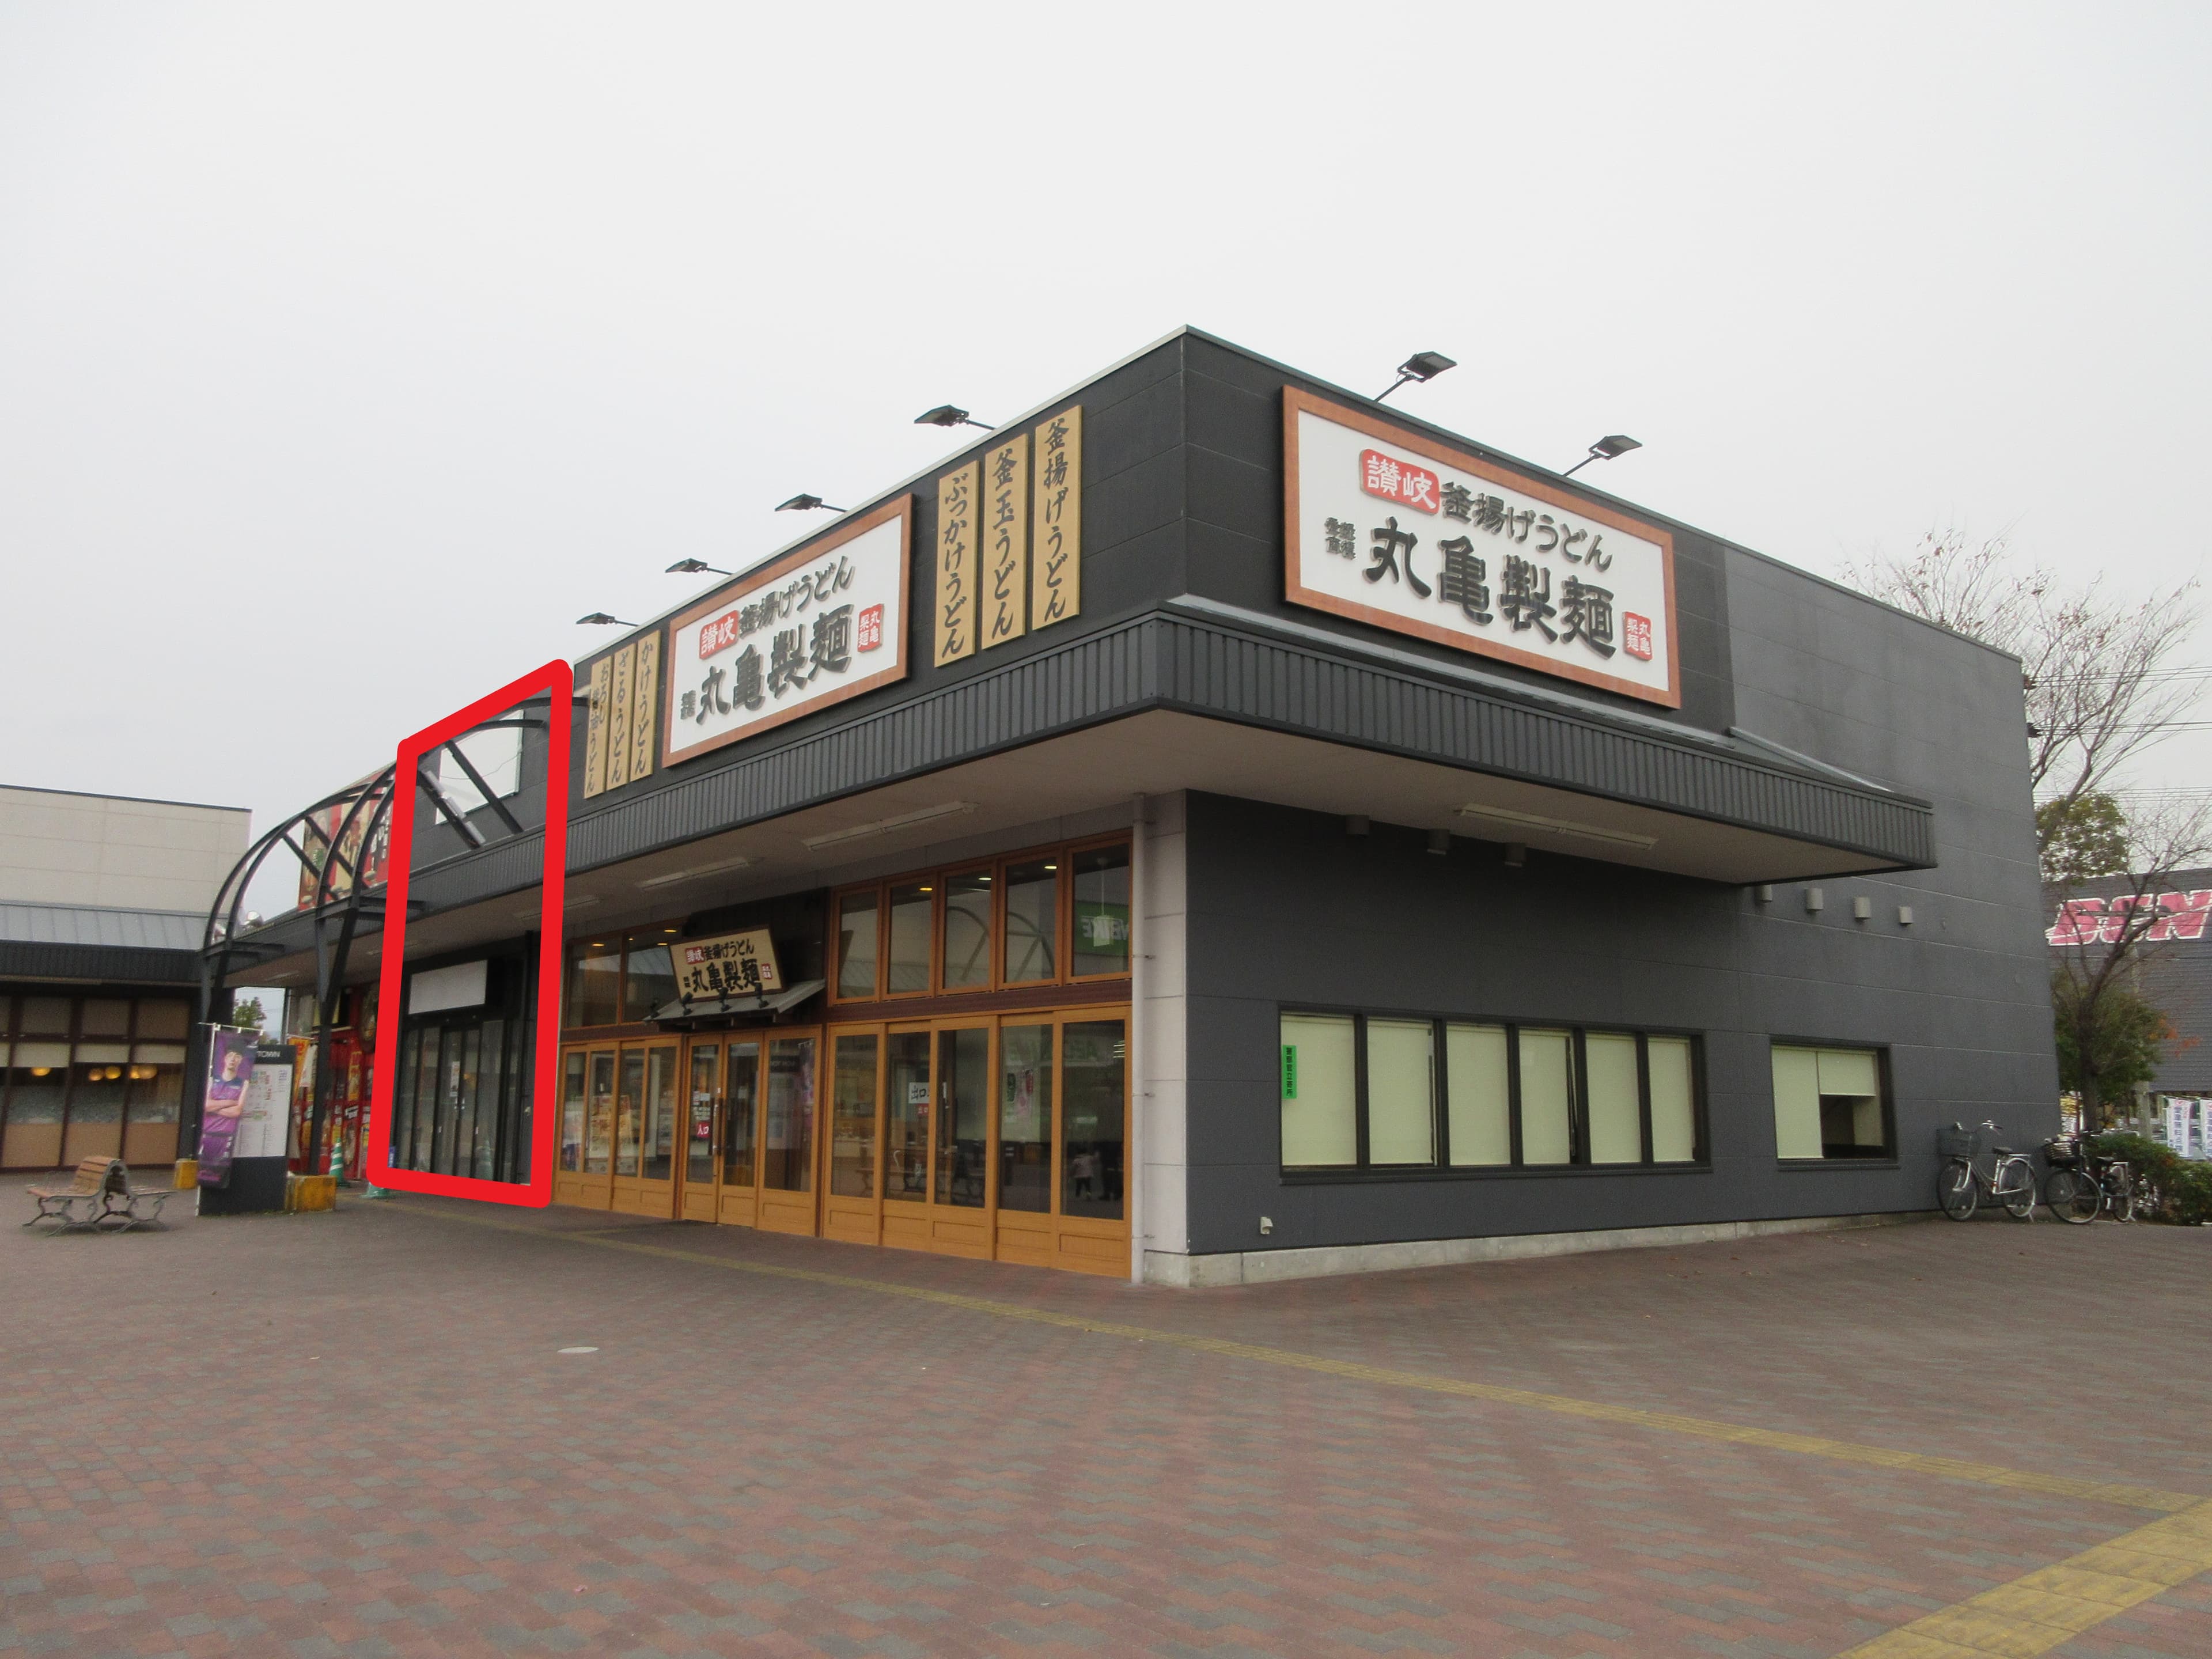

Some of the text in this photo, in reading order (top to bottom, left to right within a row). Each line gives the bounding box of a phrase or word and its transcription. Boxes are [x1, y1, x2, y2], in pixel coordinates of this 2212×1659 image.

[1044, 417, 1070, 623] 釜揚げうどん
[1366, 455, 1437, 510] 讃岐
[1440, 482, 1613, 572] 釜揚げうどん
[942, 472, 969, 658] ぶっかけうどん
[992, 448, 1017, 640] 釜玉うどん
[1362, 516, 1617, 659] 丸亀製麺
[700, 615, 737, 655] 讃岐
[739, 556, 855, 639] 釜揚げうどん
[635, 641, 653, 774] かけうどん
[696, 604, 855, 725] 丸亀製麺
[691, 958, 762, 993] 丸亀製麺
[704, 938, 755, 961] 釜揚げうどん
